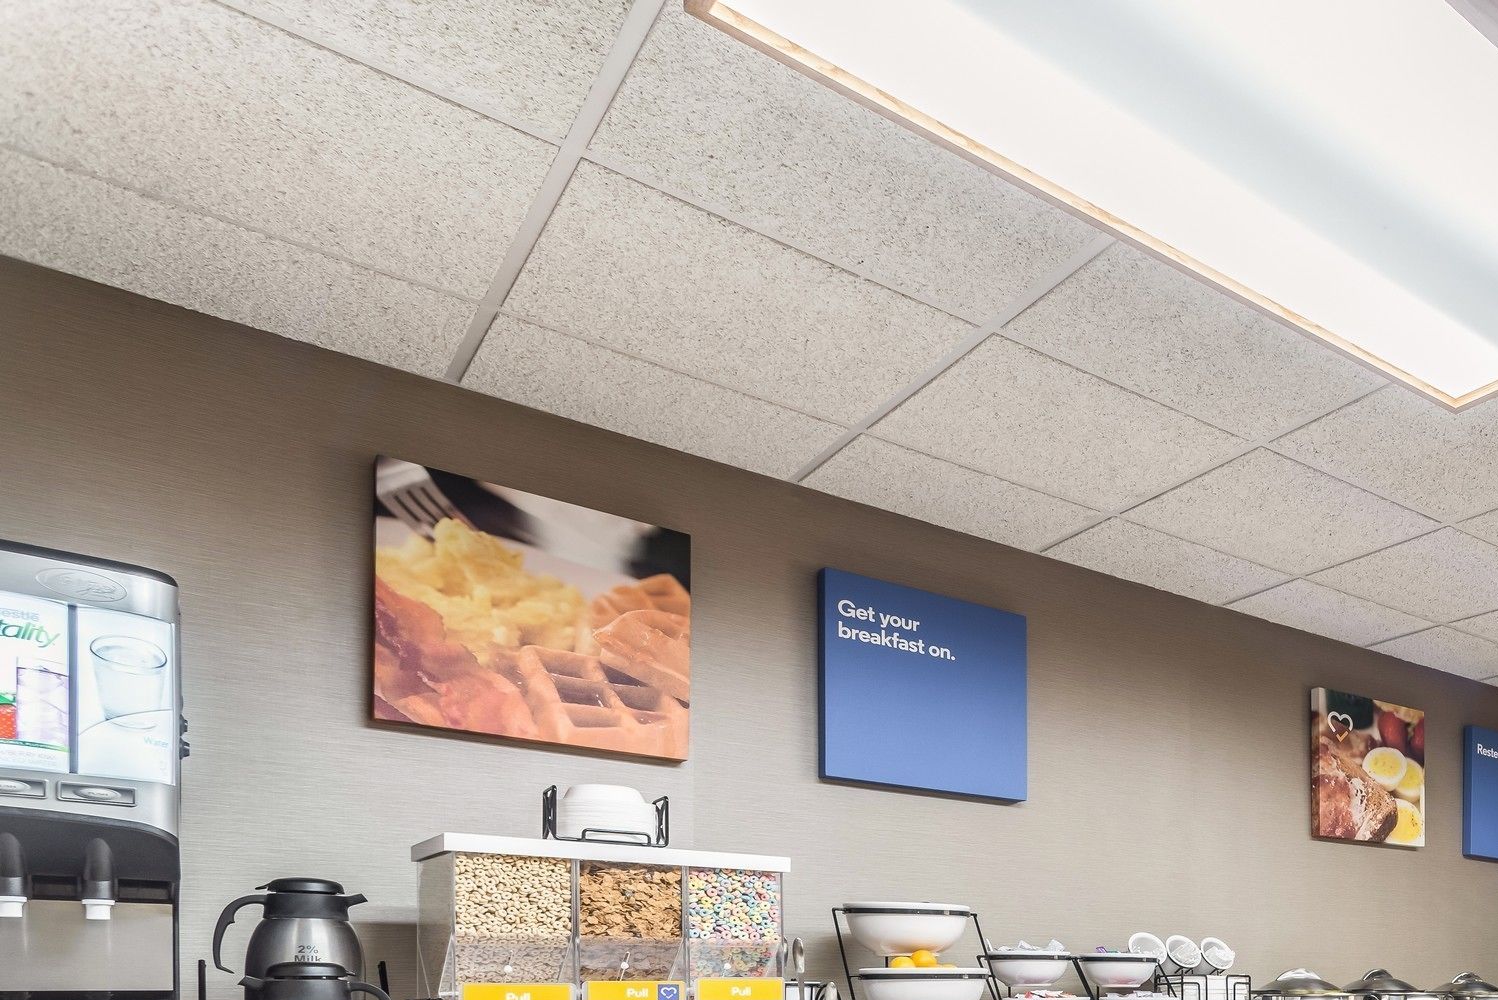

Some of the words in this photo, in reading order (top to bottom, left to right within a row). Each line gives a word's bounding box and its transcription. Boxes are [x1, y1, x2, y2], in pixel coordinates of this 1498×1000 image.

[838, 599, 876, 623] Get
[879, 612, 920, 632] your
[0, 619, 60, 649] tality
[838, 620, 925, 655] breakfast
[928, 645, 956, 661] on.
[144, 736, 169, 749] Water
[297, 945, 319, 954] 2%
[627, 988, 649, 999] Pull
[731, 987, 752, 997] Pull
